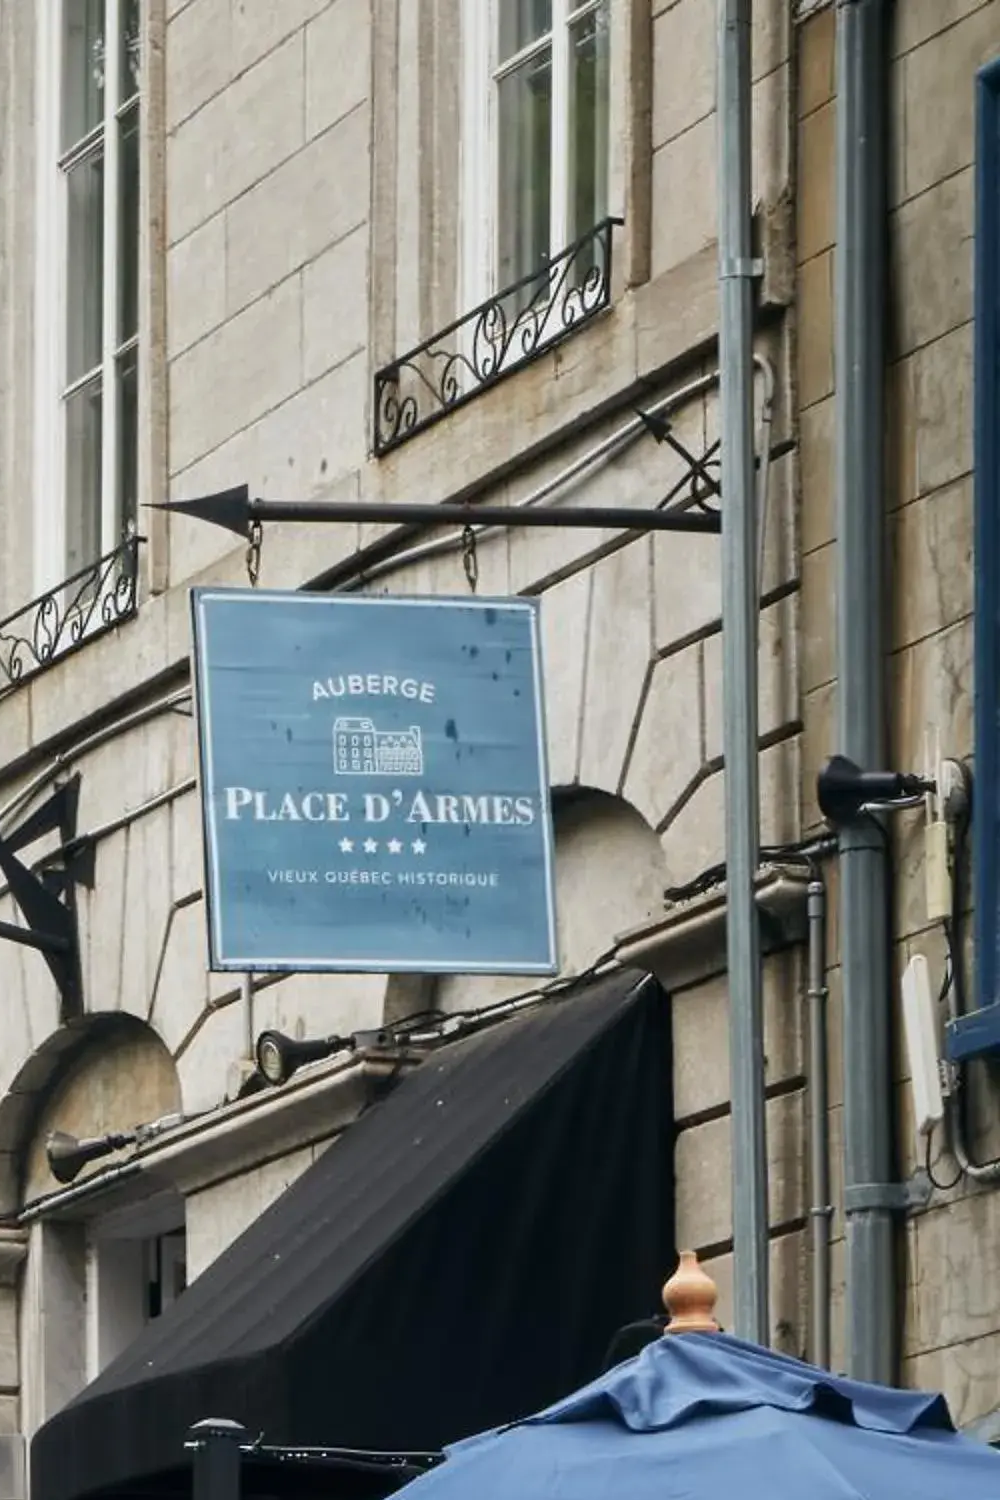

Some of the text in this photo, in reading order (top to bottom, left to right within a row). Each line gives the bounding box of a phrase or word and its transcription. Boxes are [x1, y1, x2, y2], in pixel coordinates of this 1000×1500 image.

[312, 674, 436, 704] AUBERGE
[225, 786, 534, 827] PLACE D'ARMES
[267, 867, 498, 888] VIEUX QUÉBEC HISTORIQUE
